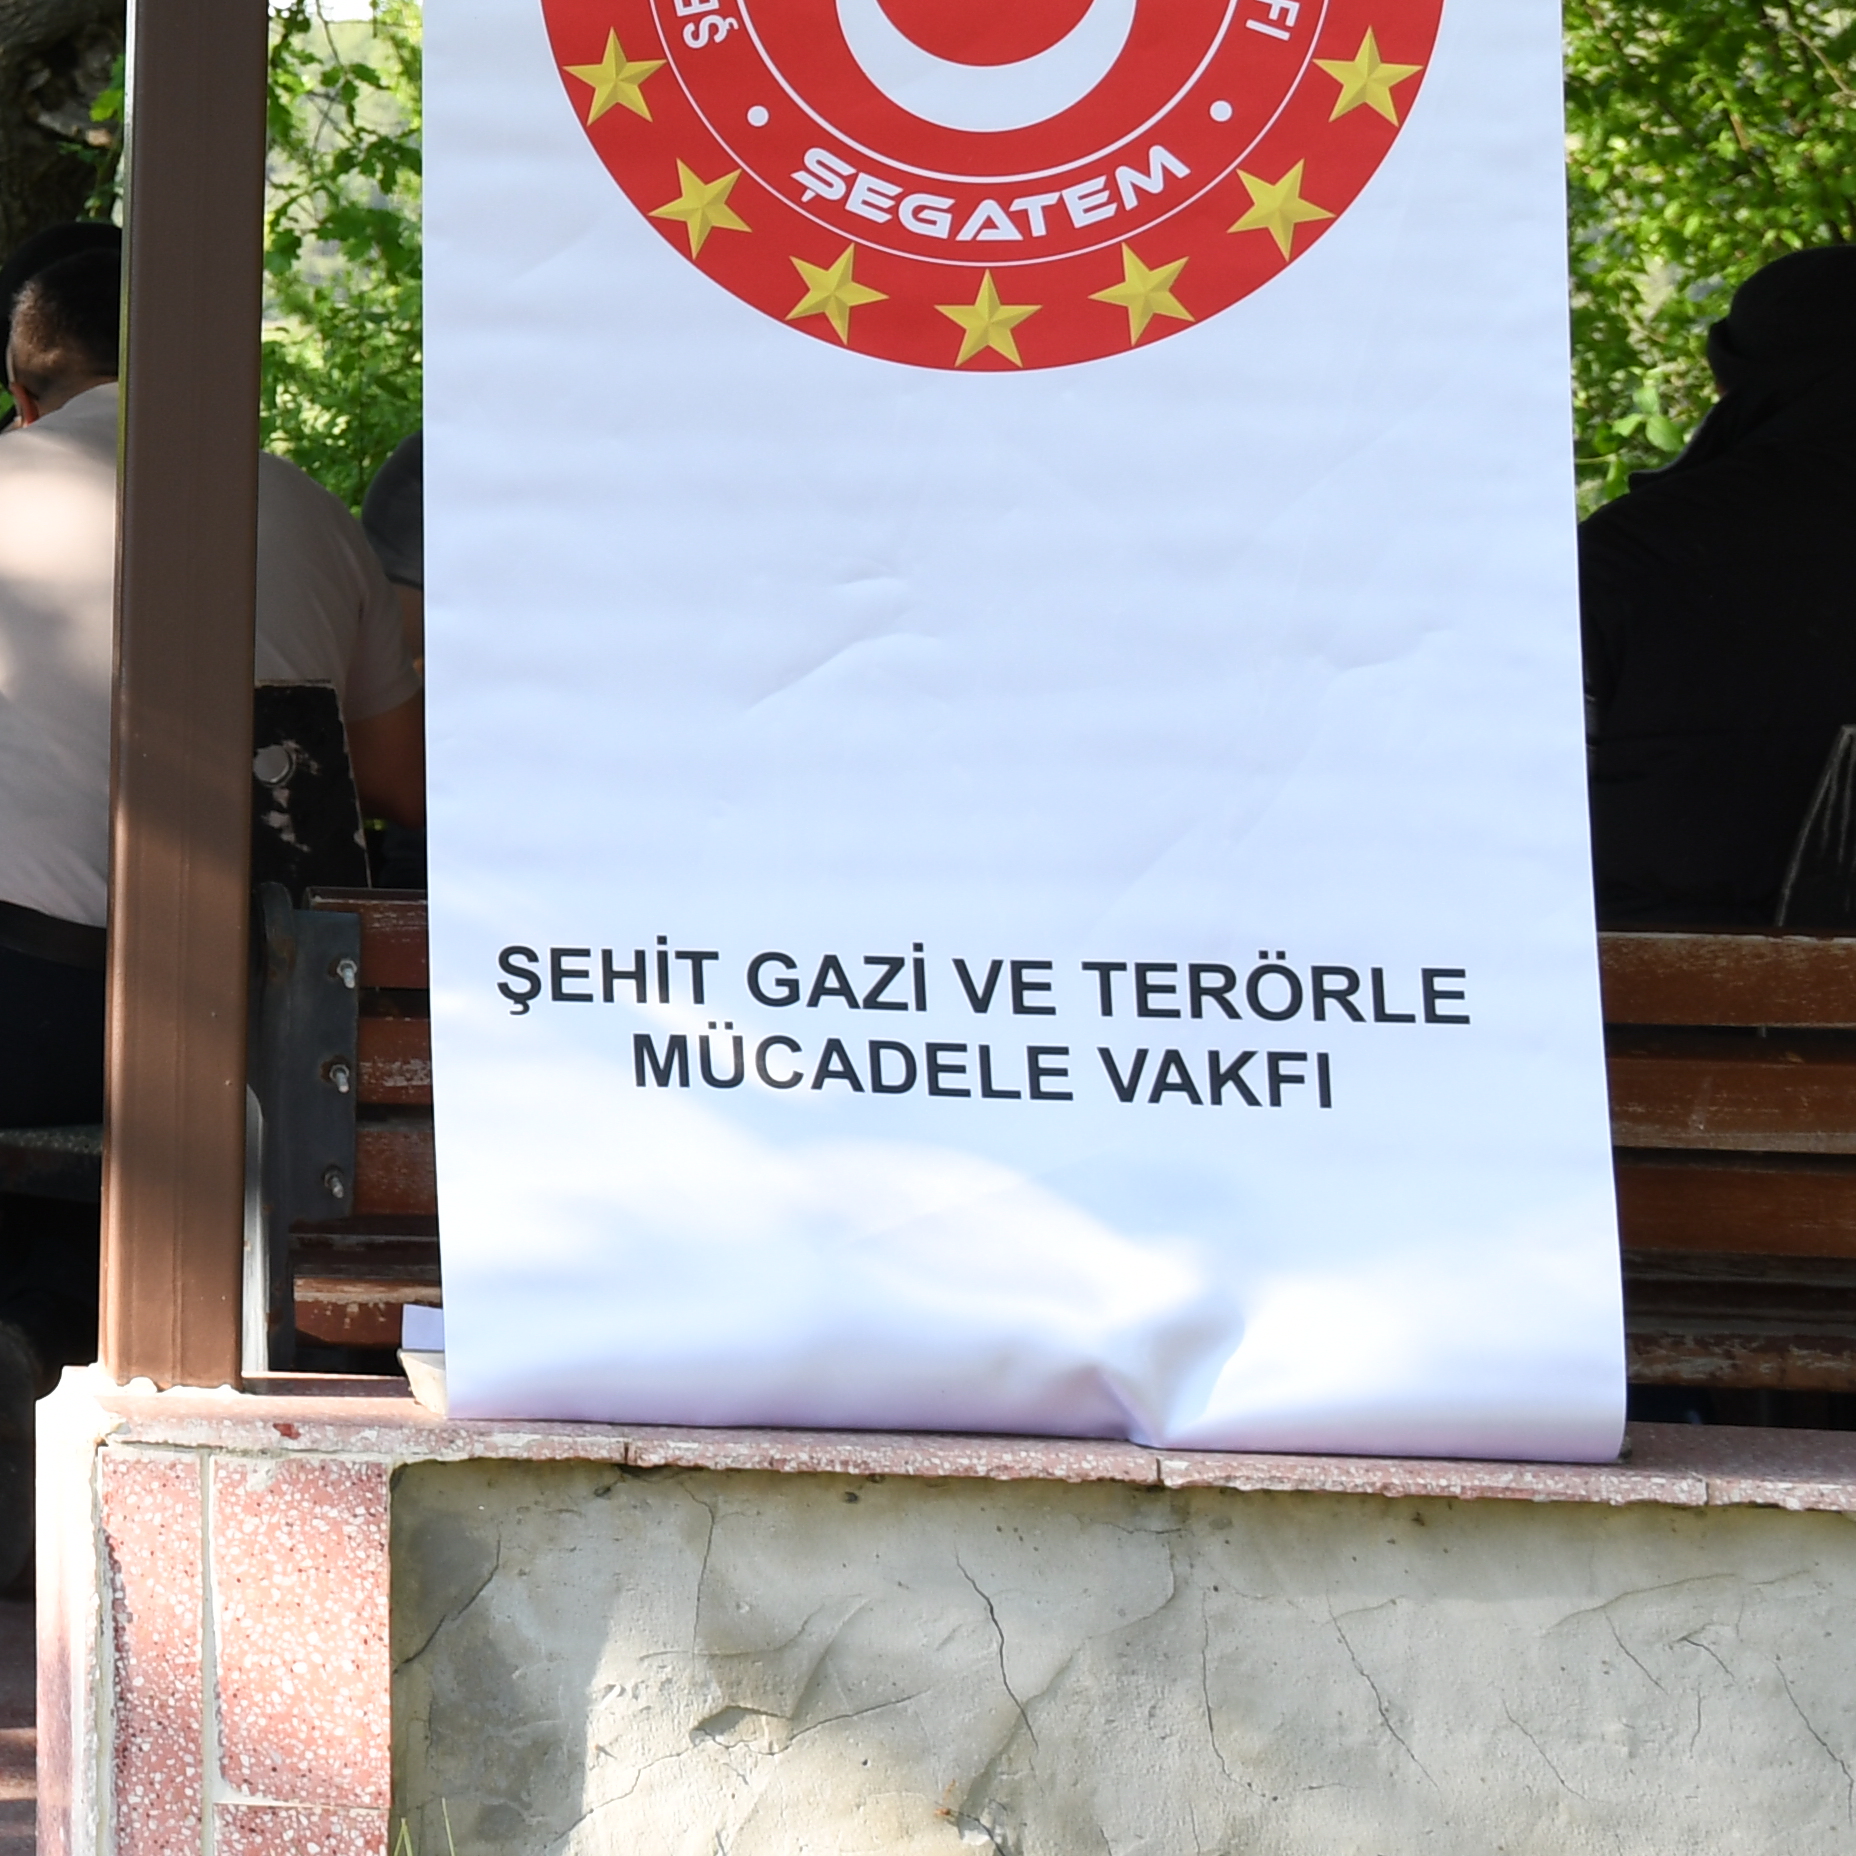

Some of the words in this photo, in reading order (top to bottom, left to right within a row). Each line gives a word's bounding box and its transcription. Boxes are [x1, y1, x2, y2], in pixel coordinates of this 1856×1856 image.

[790, 144, 1192, 242] ŞEGATEM
[496, 934, 720, 1016] ŞEHİT
[746, 941, 928, 1013] GAZİ
[951, 957, 1057, 1016] VE
[1080, 949, 1472, 1025] TERÖRLE
[632, 1020, 1074, 1101] MÜCADELE
[1096, 1046, 1333, 1109] VAKFI
